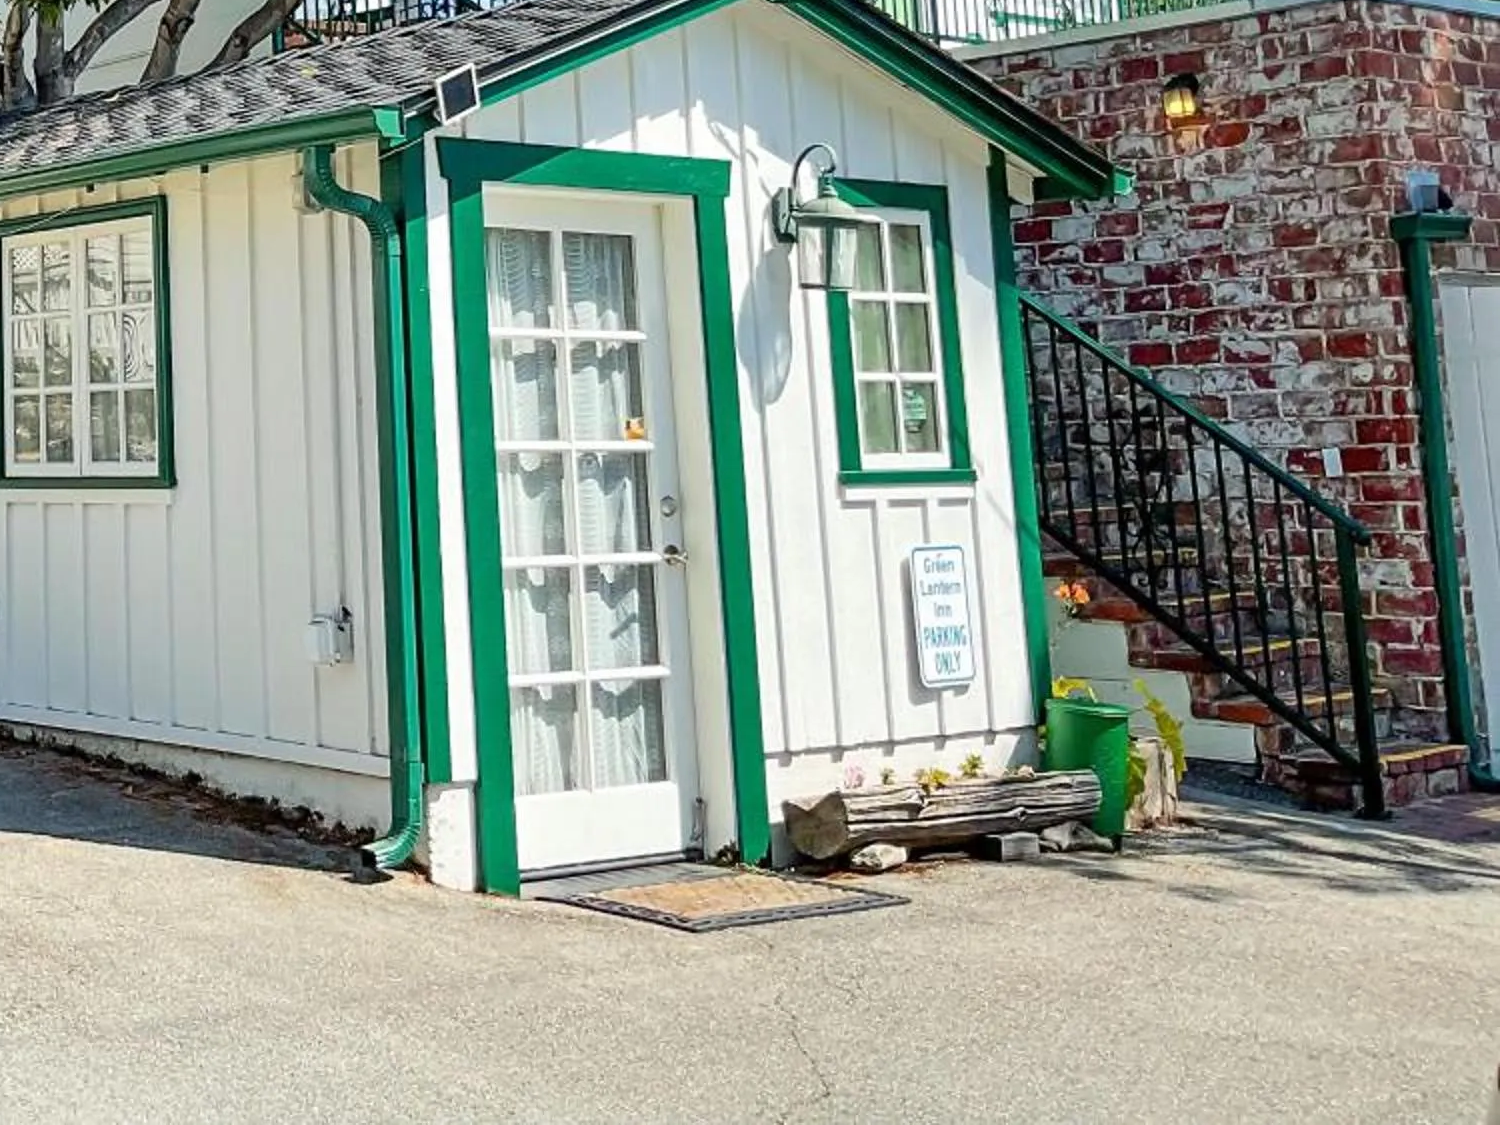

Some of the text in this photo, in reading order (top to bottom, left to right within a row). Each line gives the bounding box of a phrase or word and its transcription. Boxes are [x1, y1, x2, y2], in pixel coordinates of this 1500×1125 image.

[923, 557, 955, 574] Green
[919, 579, 961, 597] Lantern
[933, 602, 953, 618] Inn
[923, 625, 967, 649] PARKING
[934, 650, 961, 675] ONLY
